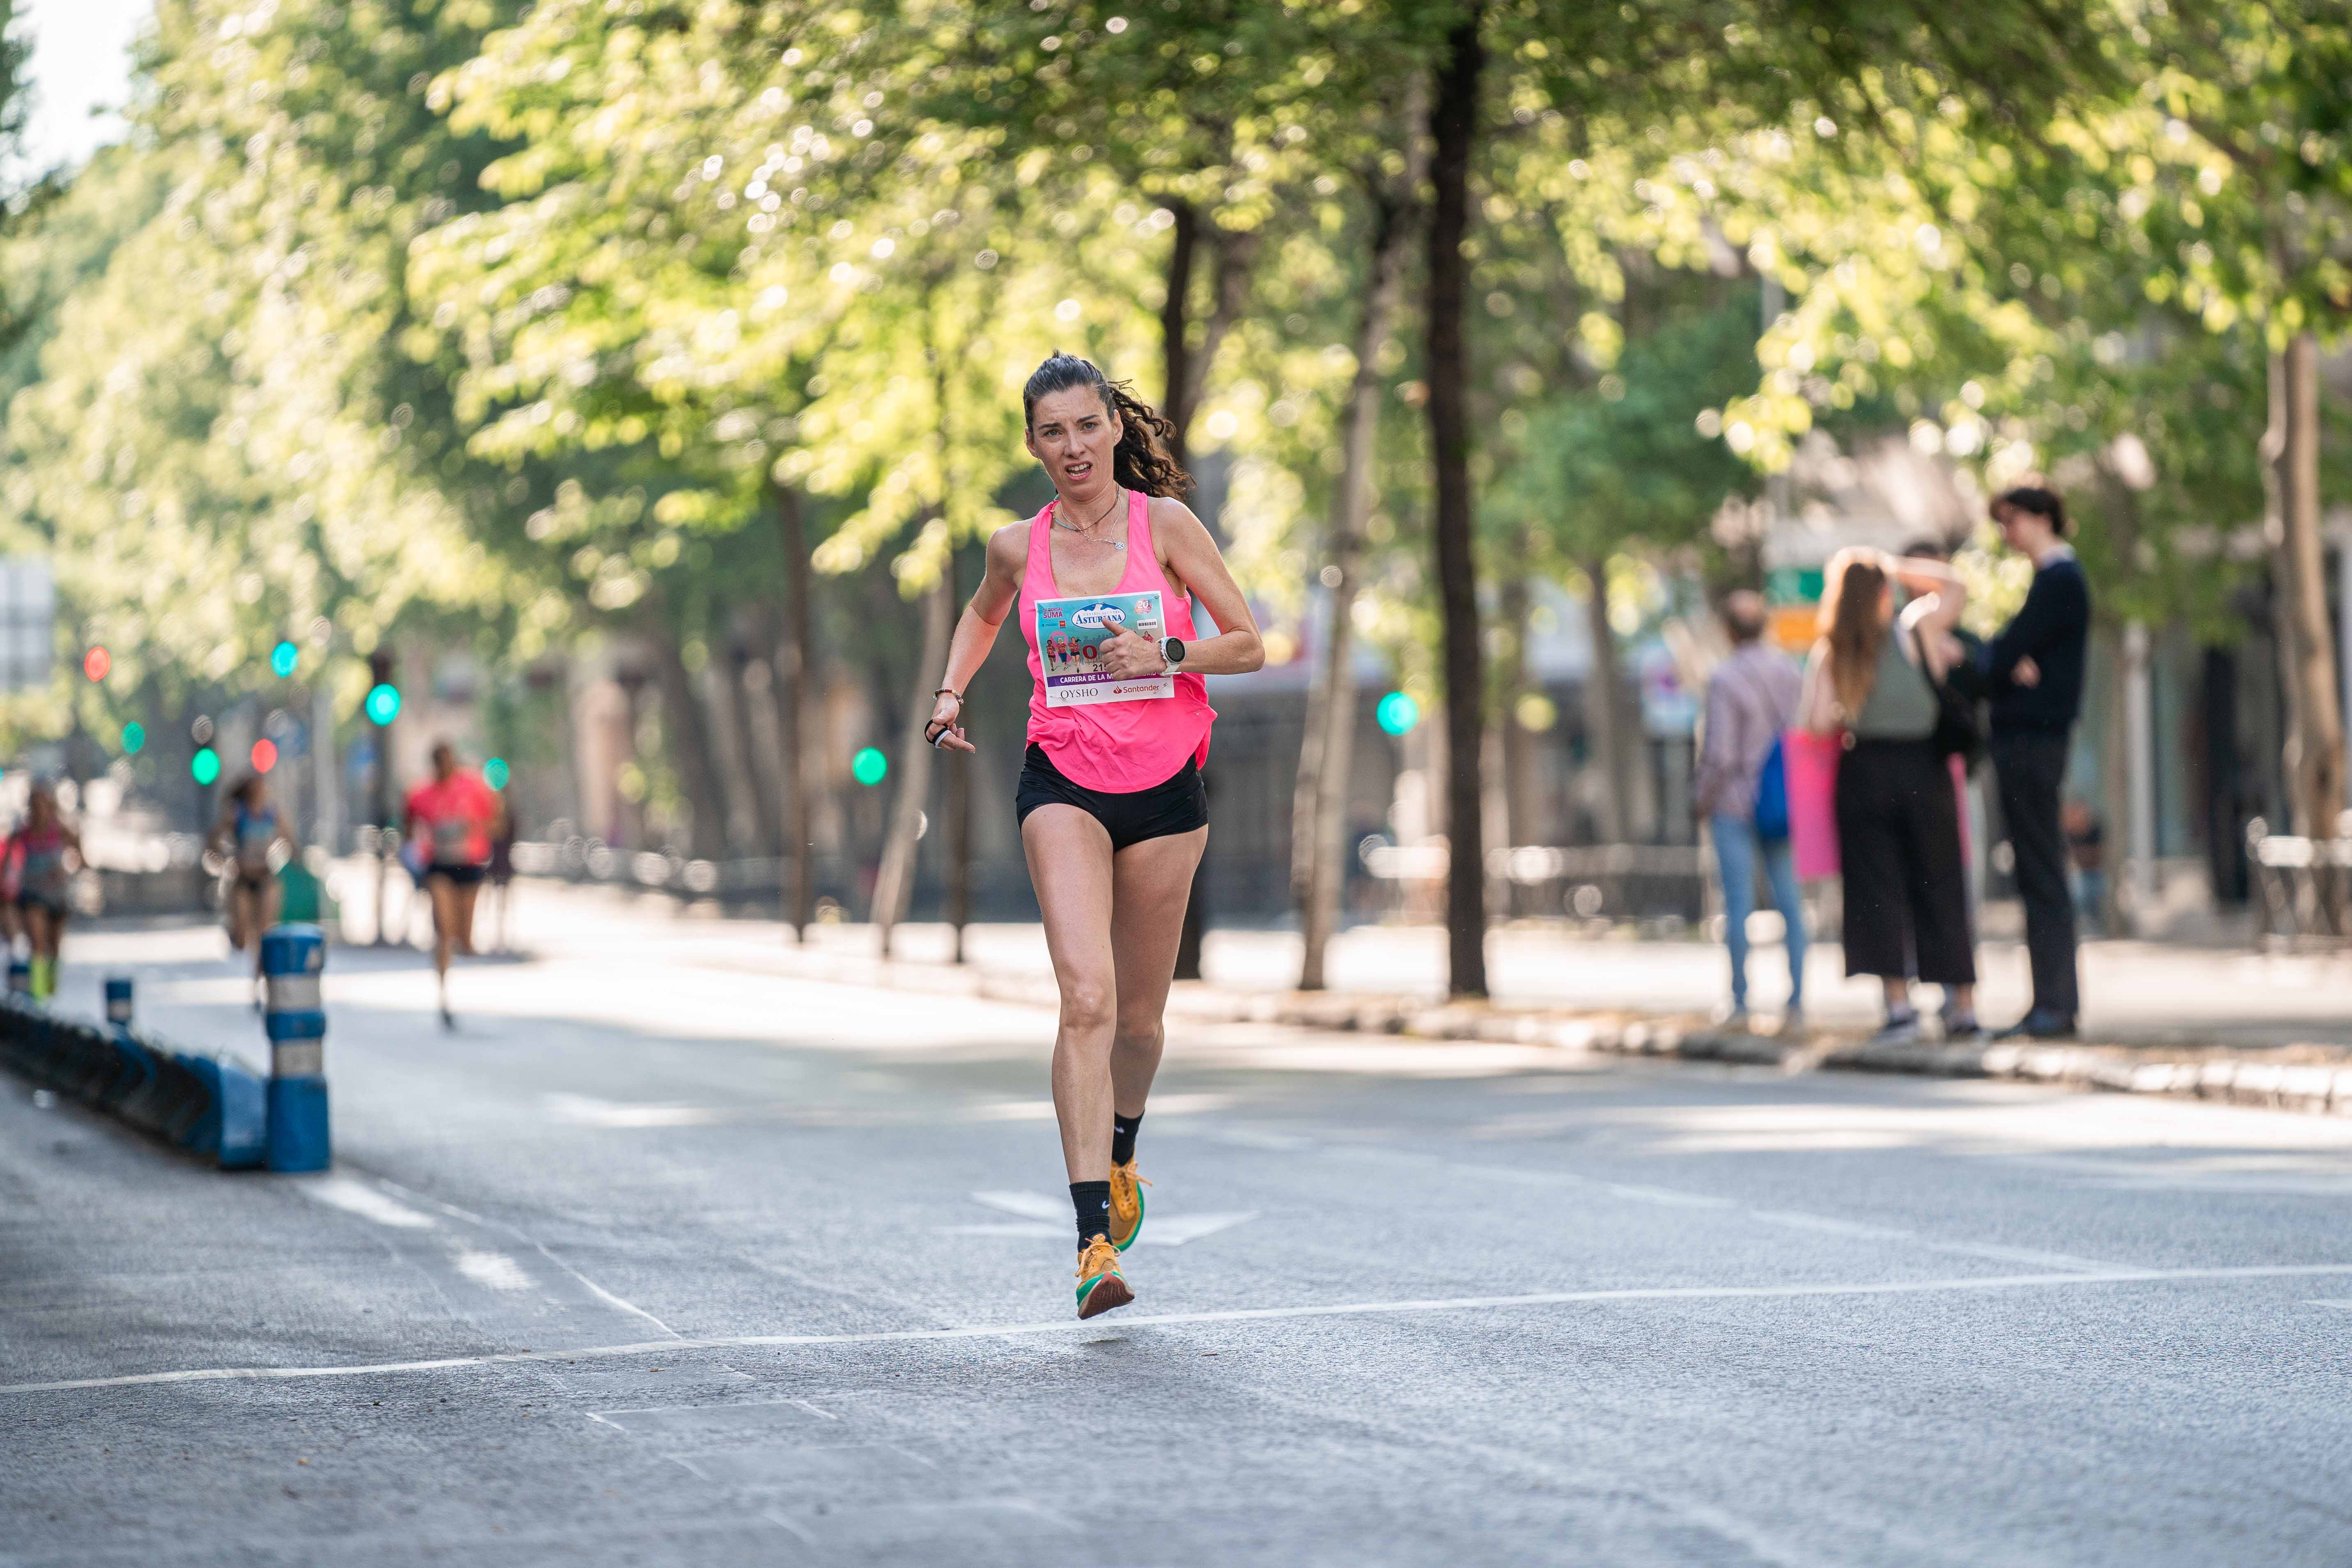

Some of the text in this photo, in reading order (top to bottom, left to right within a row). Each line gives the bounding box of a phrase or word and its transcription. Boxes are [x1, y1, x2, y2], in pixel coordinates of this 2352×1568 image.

[1076, 614, 1122, 624] ASTURANA
[1060, 688, 1098, 699] OYSHO
[1123, 684, 1159, 693] Santander
